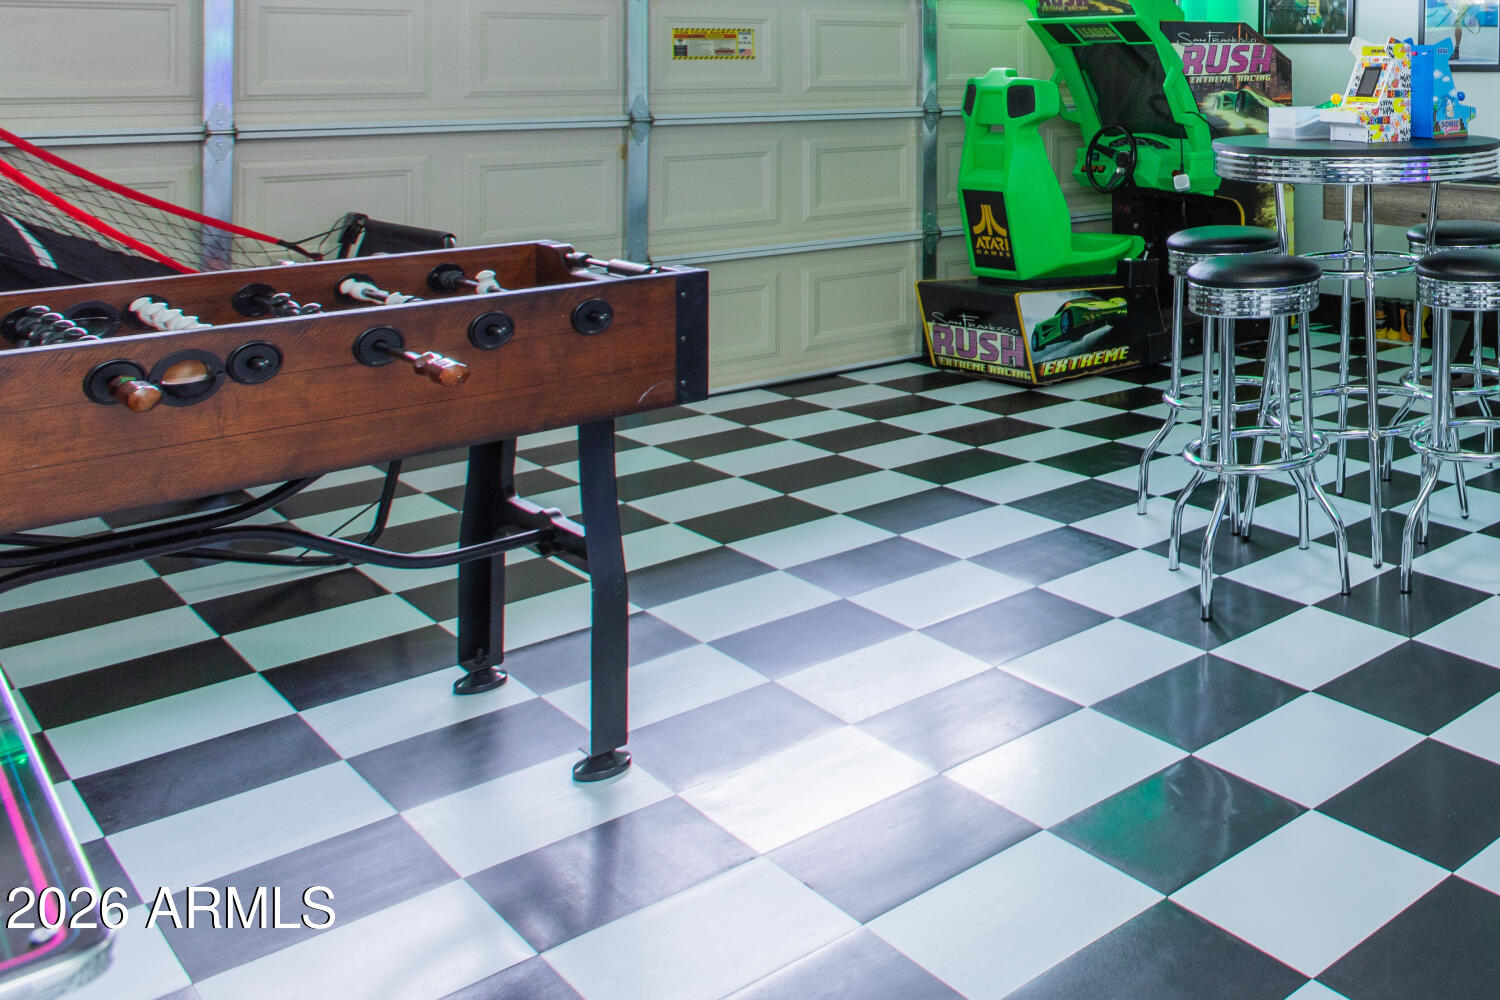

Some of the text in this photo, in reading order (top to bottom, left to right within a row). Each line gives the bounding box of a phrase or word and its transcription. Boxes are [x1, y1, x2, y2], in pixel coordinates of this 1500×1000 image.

[1182, 44, 1273, 75] RUSH
[1189, 73, 1272, 84] EXTREME RACING
[976, 235, 1010, 252] ATARI
[932, 323, 1025, 368] RUSH
[938, 356, 1032, 380] EXTREME RACING
[1040, 345, 1130, 377] EXTREME
